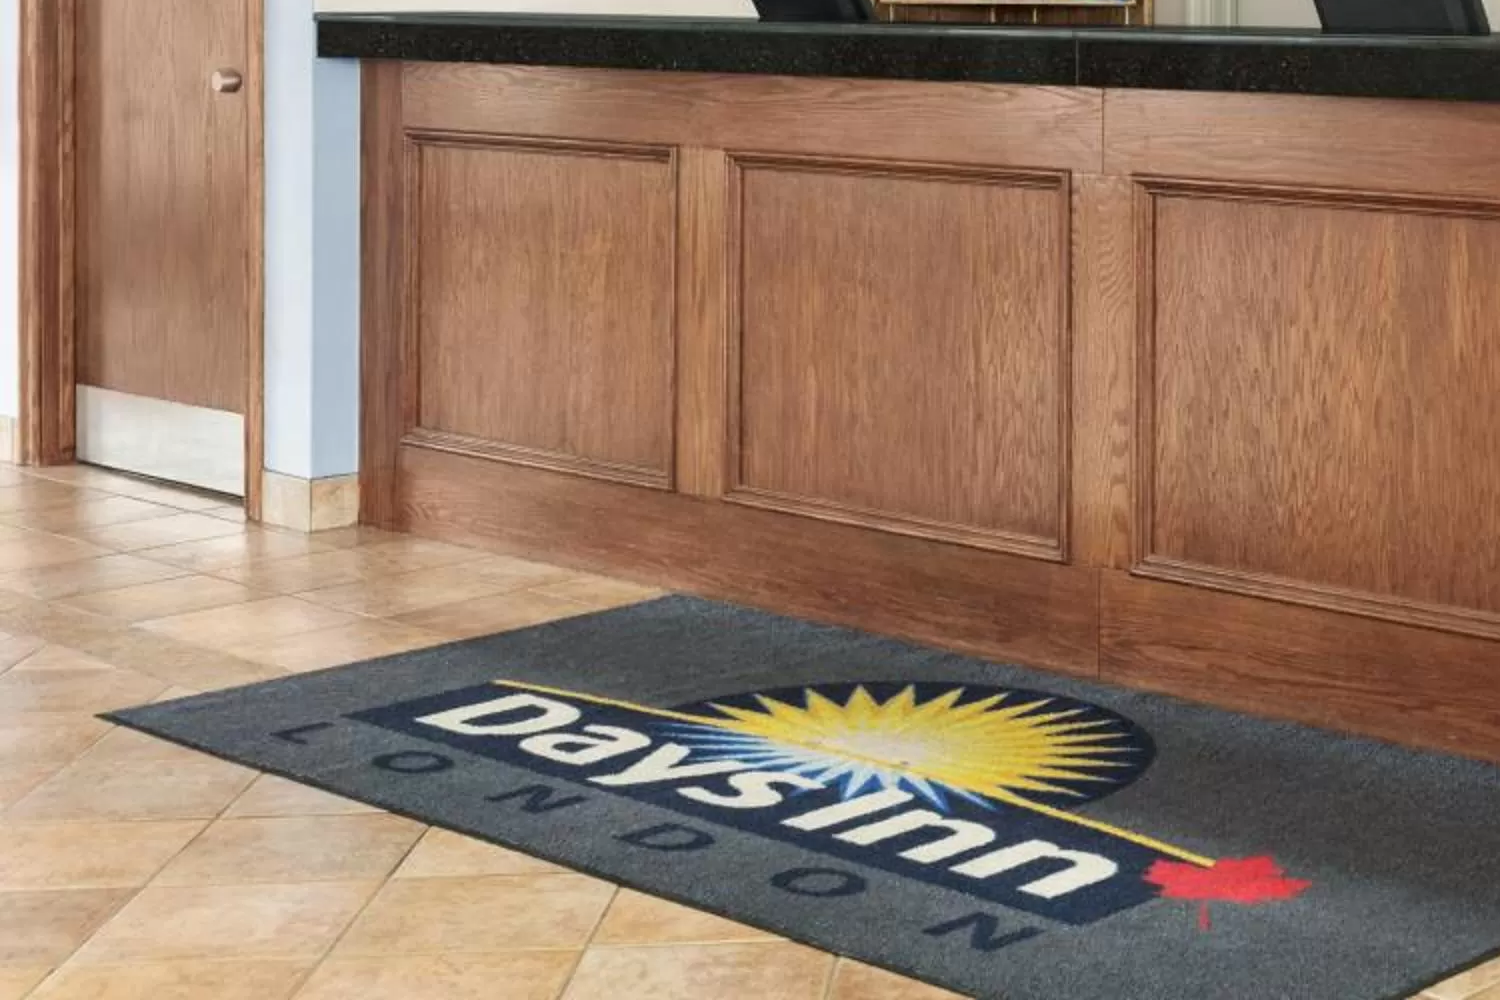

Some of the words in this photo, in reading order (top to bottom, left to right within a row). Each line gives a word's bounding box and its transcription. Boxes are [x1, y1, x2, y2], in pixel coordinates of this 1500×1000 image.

[270, 721, 1047, 953] LONDON
[415, 693, 825, 809] Days
[780, 787, 1118, 899] Inn
